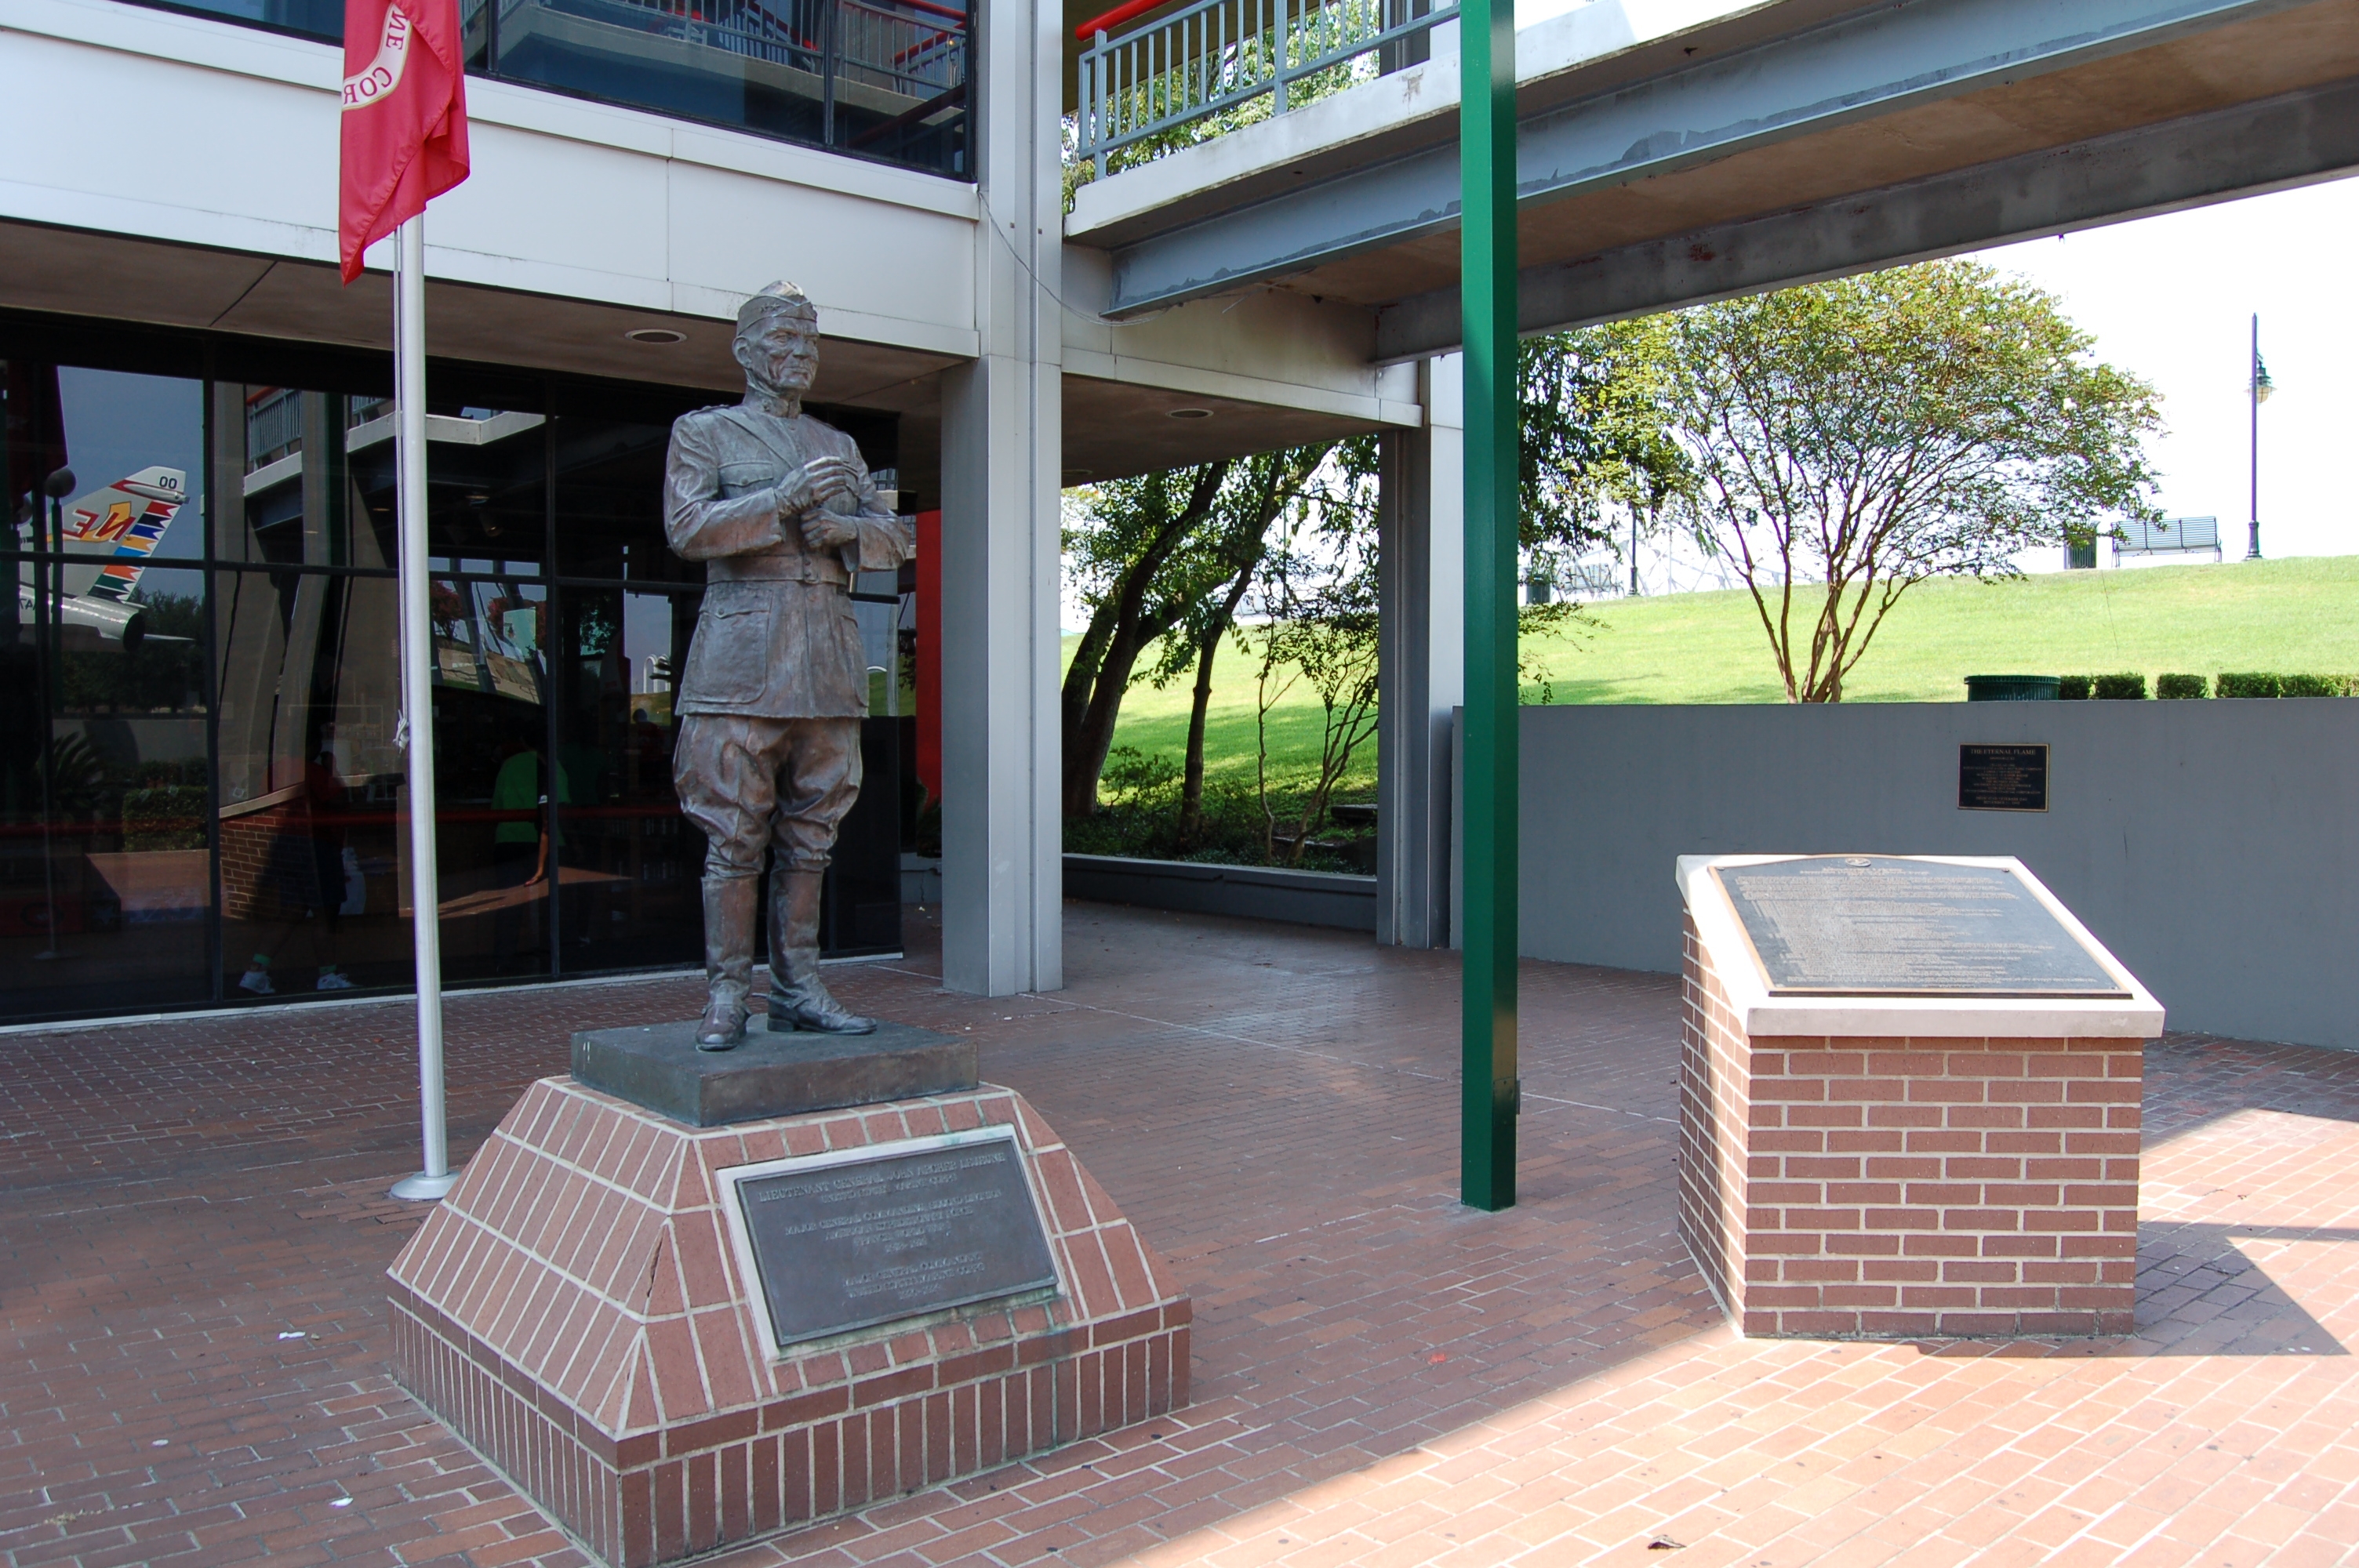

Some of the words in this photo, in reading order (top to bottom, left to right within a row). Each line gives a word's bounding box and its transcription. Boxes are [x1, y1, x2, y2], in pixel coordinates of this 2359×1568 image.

[758, 1181, 830, 1203] LIEUTENANT
[833, 1174, 884, 1189] GENERAL
[886, 1170, 915, 1181] JOHN
[918, 1160, 957, 1176] ARCHER
[960, 1152, 1006, 1169] LEJEUNE
[785, 1223, 817, 1236] MAJOR
[819, 1214, 861, 1229] GENERAL
